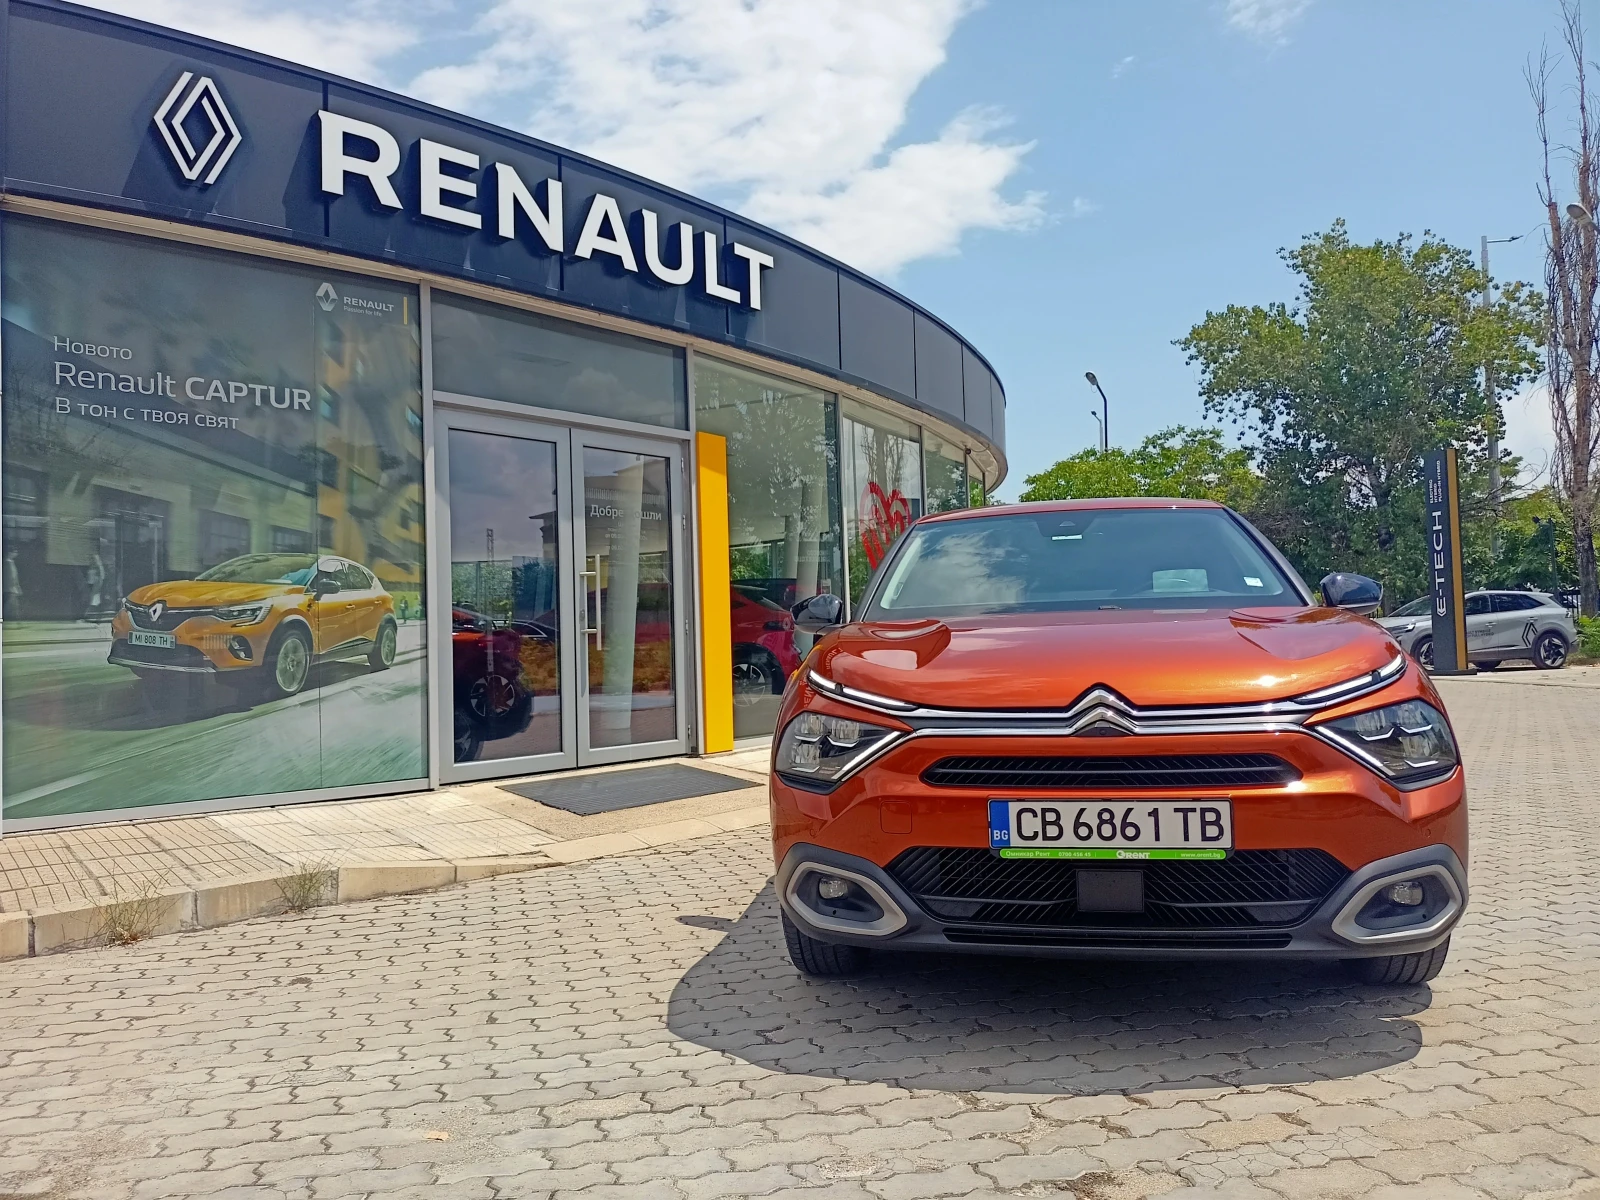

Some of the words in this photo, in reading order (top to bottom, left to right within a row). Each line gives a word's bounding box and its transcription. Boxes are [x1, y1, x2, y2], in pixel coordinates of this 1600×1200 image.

[318, 109, 774, 310] RENAULT
[343, 296, 394, 312] RENAULT
[343, 305, 364, 314] Passion
[365, 308, 373, 316] for
[53, 336, 133, 361] Новото
[54, 361, 176, 398] Renault
[185, 376, 312, 411] CAPTUR
[55, 397, 71, 414] В
[80, 402, 117, 419] тон
[141, 408, 189, 425] твоя
[194, 413, 240, 430] свят
[590, 504, 624, 520] Добре
[629, 510, 662, 521] ошли
[1432, 510, 1446, 617] E-TECH
[994, 829, 1009, 840] BG
[1016, 807, 1064, 842] CB
[1073, 807, 1161, 842] 6861
[1173, 807, 1225, 842] TB
